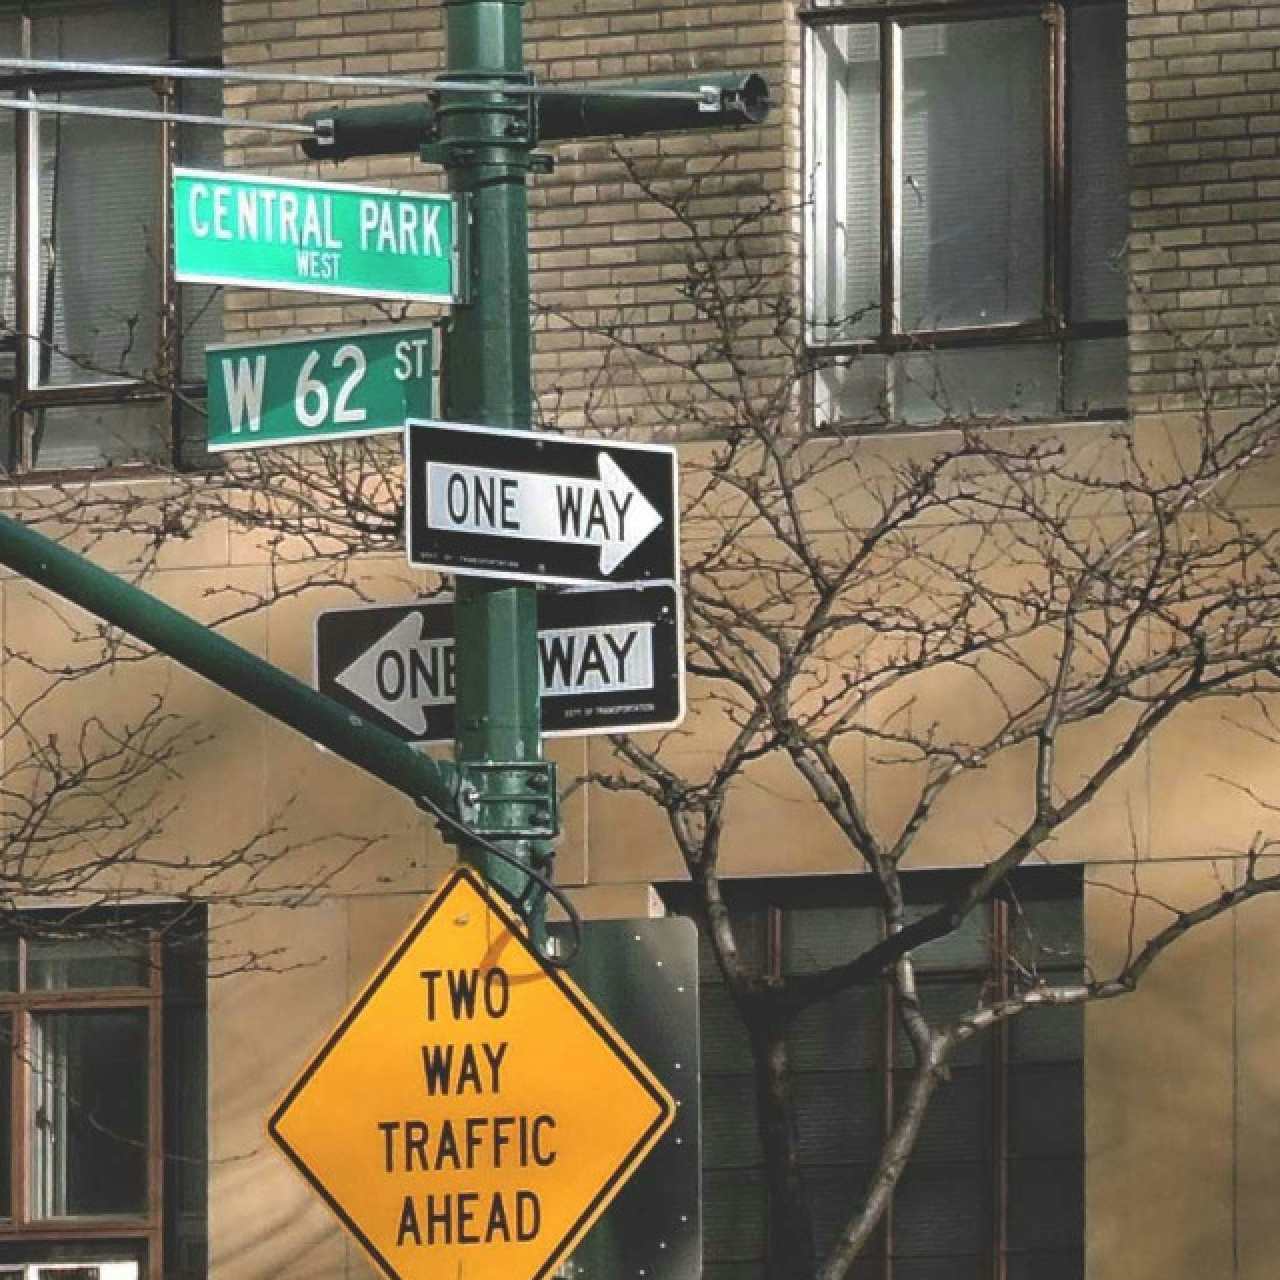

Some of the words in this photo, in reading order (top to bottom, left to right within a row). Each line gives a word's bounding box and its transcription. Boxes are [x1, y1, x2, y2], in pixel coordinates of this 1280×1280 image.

[188, 183, 343, 249] CENTRAL
[359, 199, 442, 258] PARK
[296, 249, 341, 280] WEST
[221, 355, 267, 434] W
[294, 343, 367, 427] 62
[394, 339, 428, 380] ST
[447, 472, 520, 530] ONE
[555, 484, 634, 542] WAY
[540, 631, 638, 688] WAY
[420, 967, 510, 1021] TWO
[422, 1042, 508, 1096] WAY
[378, 1114, 556, 1172] TRAFFIC
[396, 1190, 541, 1246] AHEAD
